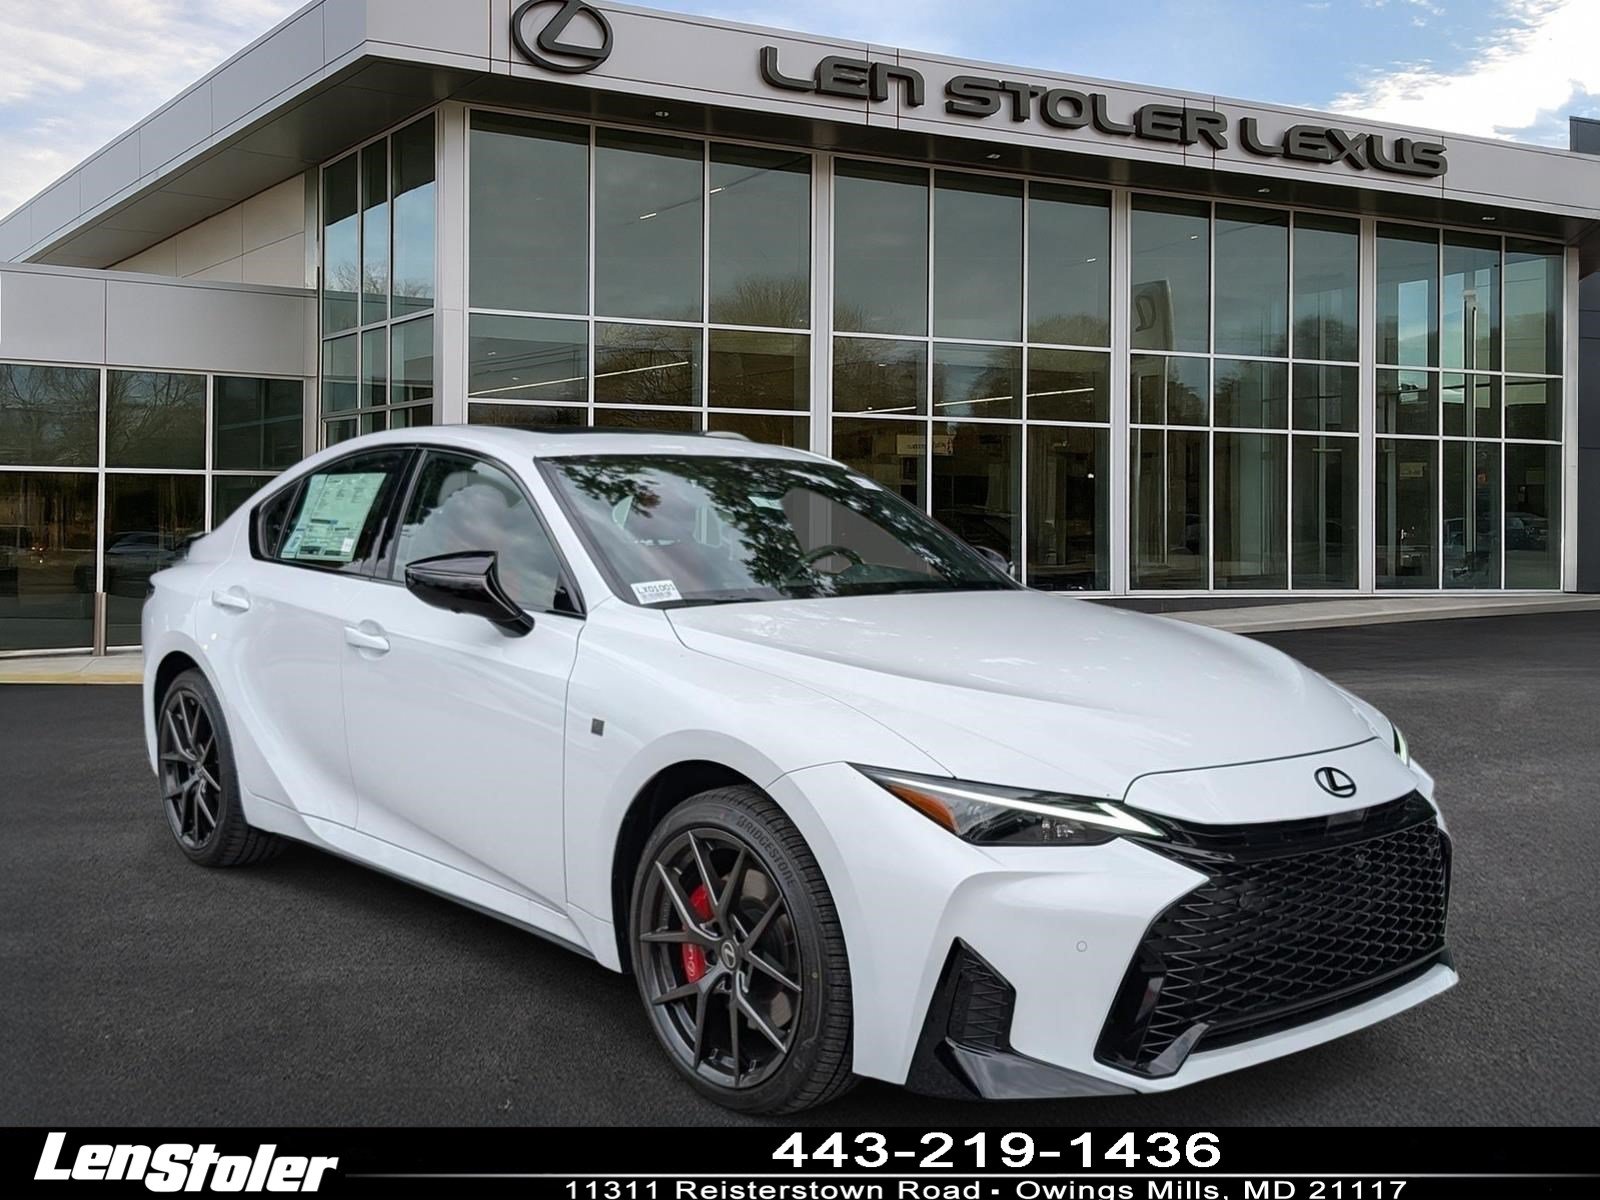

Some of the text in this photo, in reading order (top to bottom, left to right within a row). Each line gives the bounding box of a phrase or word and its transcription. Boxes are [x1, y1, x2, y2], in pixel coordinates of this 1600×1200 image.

[760, 46, 1449, 178] LEN STOLER LEXUS
[735, 815, 794, 888] BRIDGESTONE
